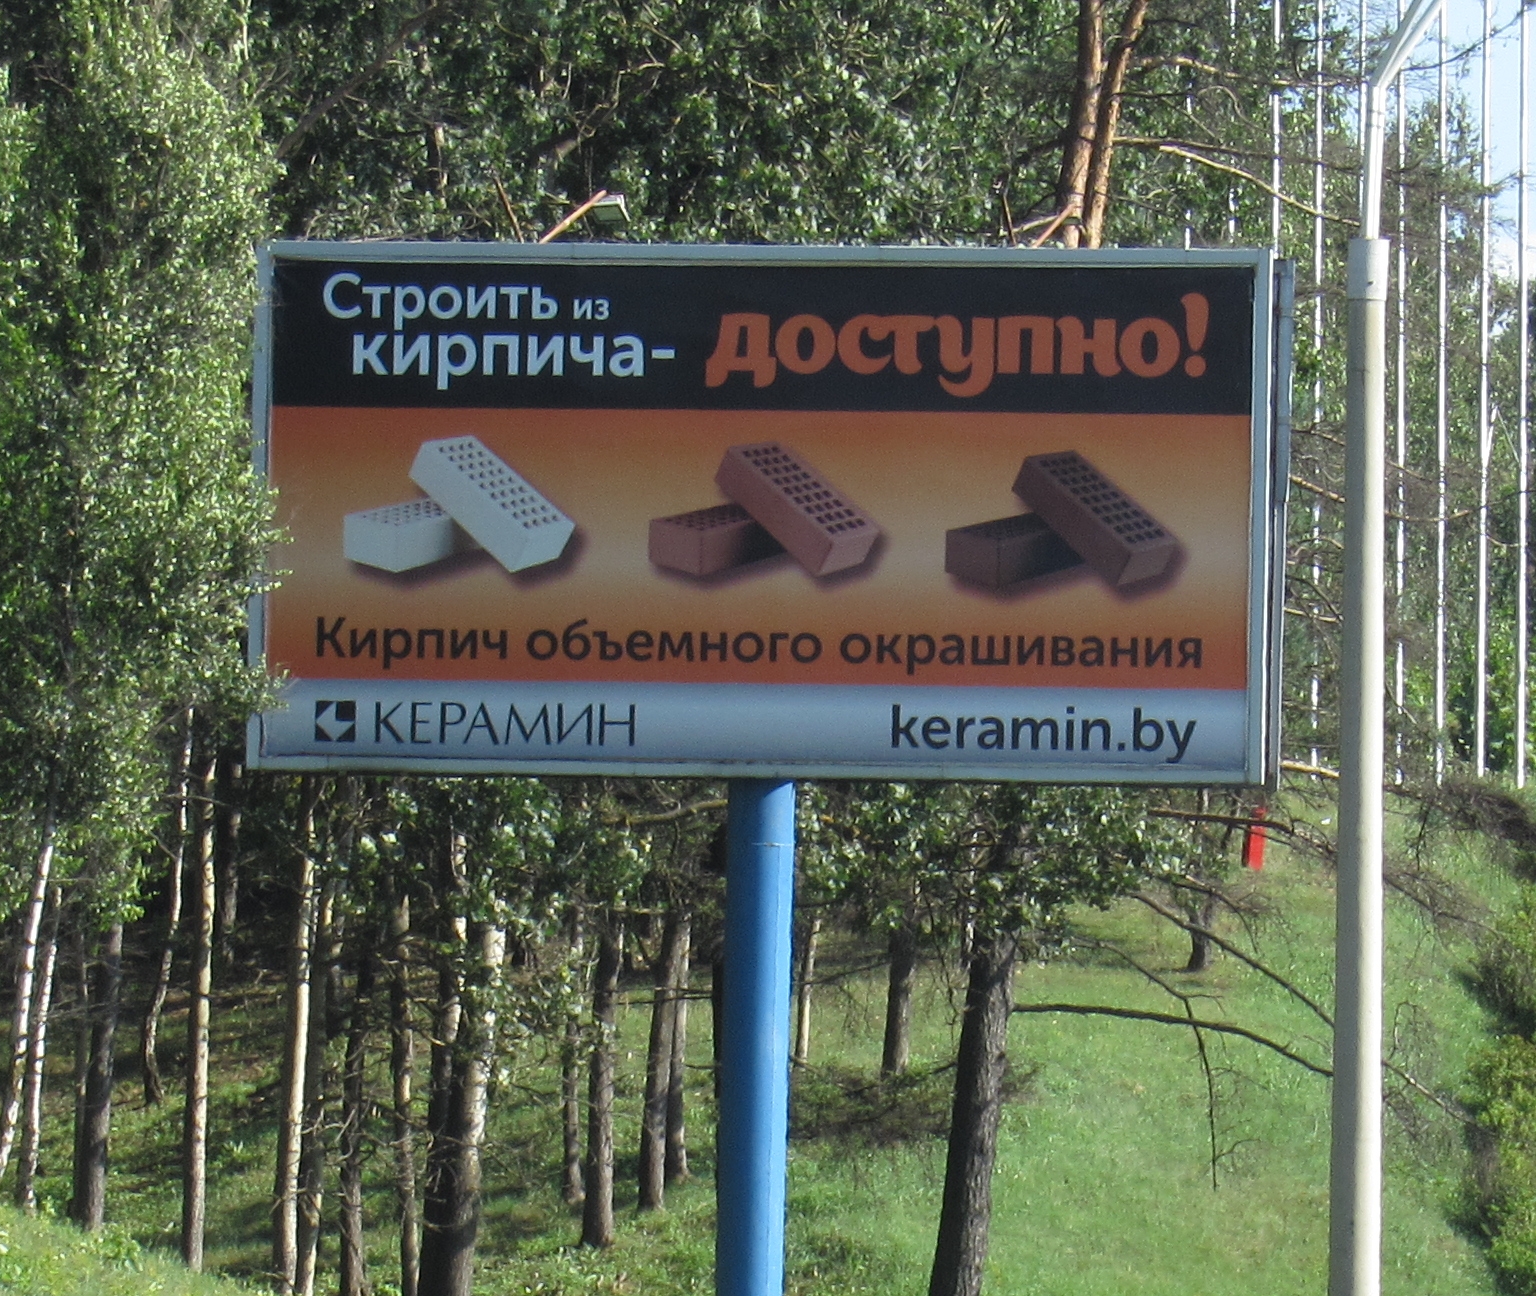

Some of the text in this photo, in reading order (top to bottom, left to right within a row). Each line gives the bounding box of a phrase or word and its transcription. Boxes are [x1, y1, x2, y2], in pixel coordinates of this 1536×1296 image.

[322, 271, 611, 330] Строить из
[351, 332, 677, 391] кирпича-
[705, 292, 1210, 398] доступно!
[315, 615, 1204, 675] Кирпич объемного окрашивания
[373, 700, 637, 747] КЕРАМИН
[890, 703, 1197, 764] keramin.by
